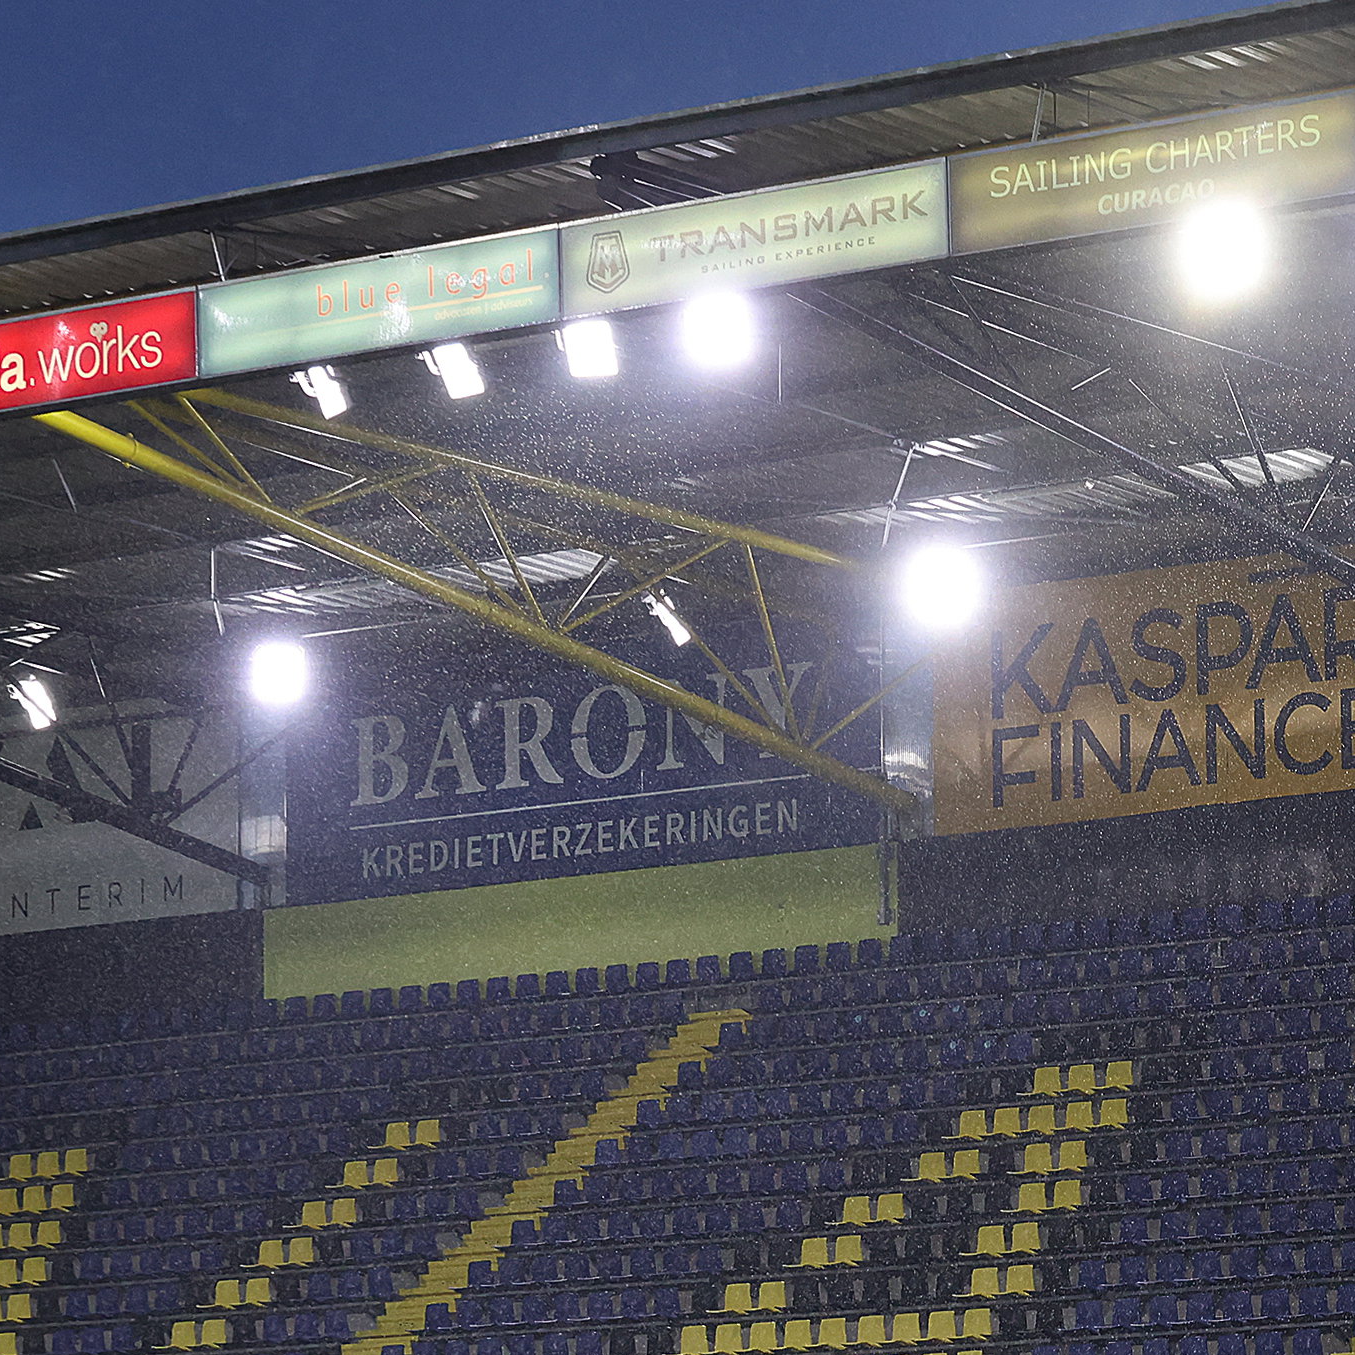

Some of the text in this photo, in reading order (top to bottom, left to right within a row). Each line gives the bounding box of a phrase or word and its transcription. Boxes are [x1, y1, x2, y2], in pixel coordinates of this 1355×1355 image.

[989, 114, 1322, 198] SAILING CHARTERS
[650, 190, 929, 263] TRANSMARK
[1097, 178, 1216, 215] CURACAO
[317, 248, 533, 316] blue legal
[701, 236, 876, 274] SAILING EXPERIENCE
[350, 662, 813, 806] BARONY
[361, 798, 799, 879] KREDIETVERZEKERINGEN
